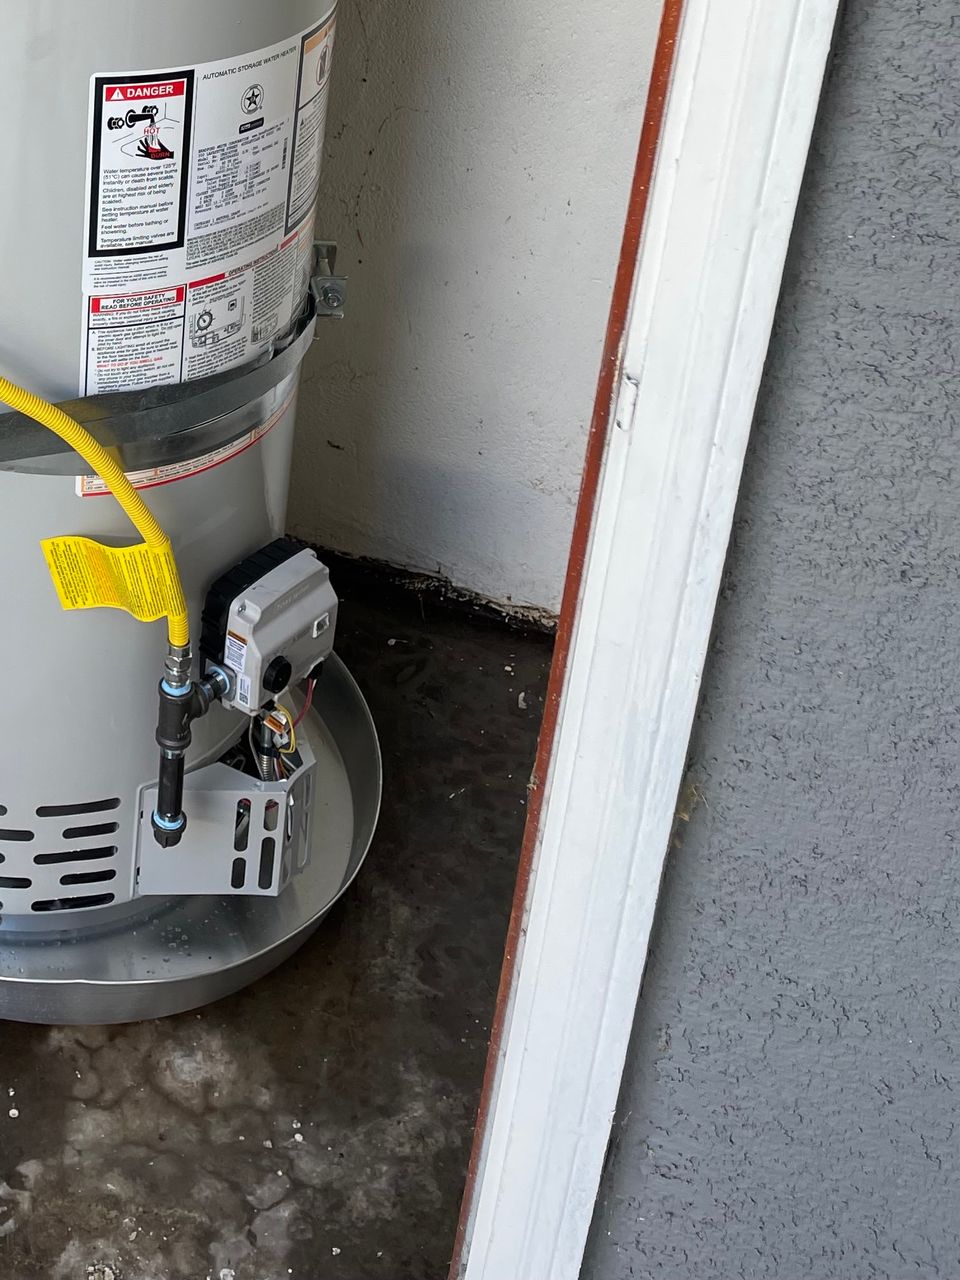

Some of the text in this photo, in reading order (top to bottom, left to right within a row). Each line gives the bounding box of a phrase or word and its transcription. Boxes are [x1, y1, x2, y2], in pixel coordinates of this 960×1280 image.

[202, 46, 296, 80] AUTOMATIC STORAGE WATER HEATER
[127, 85, 173, 97] DANGER
[143, 296, 175, 305] OPERATING
